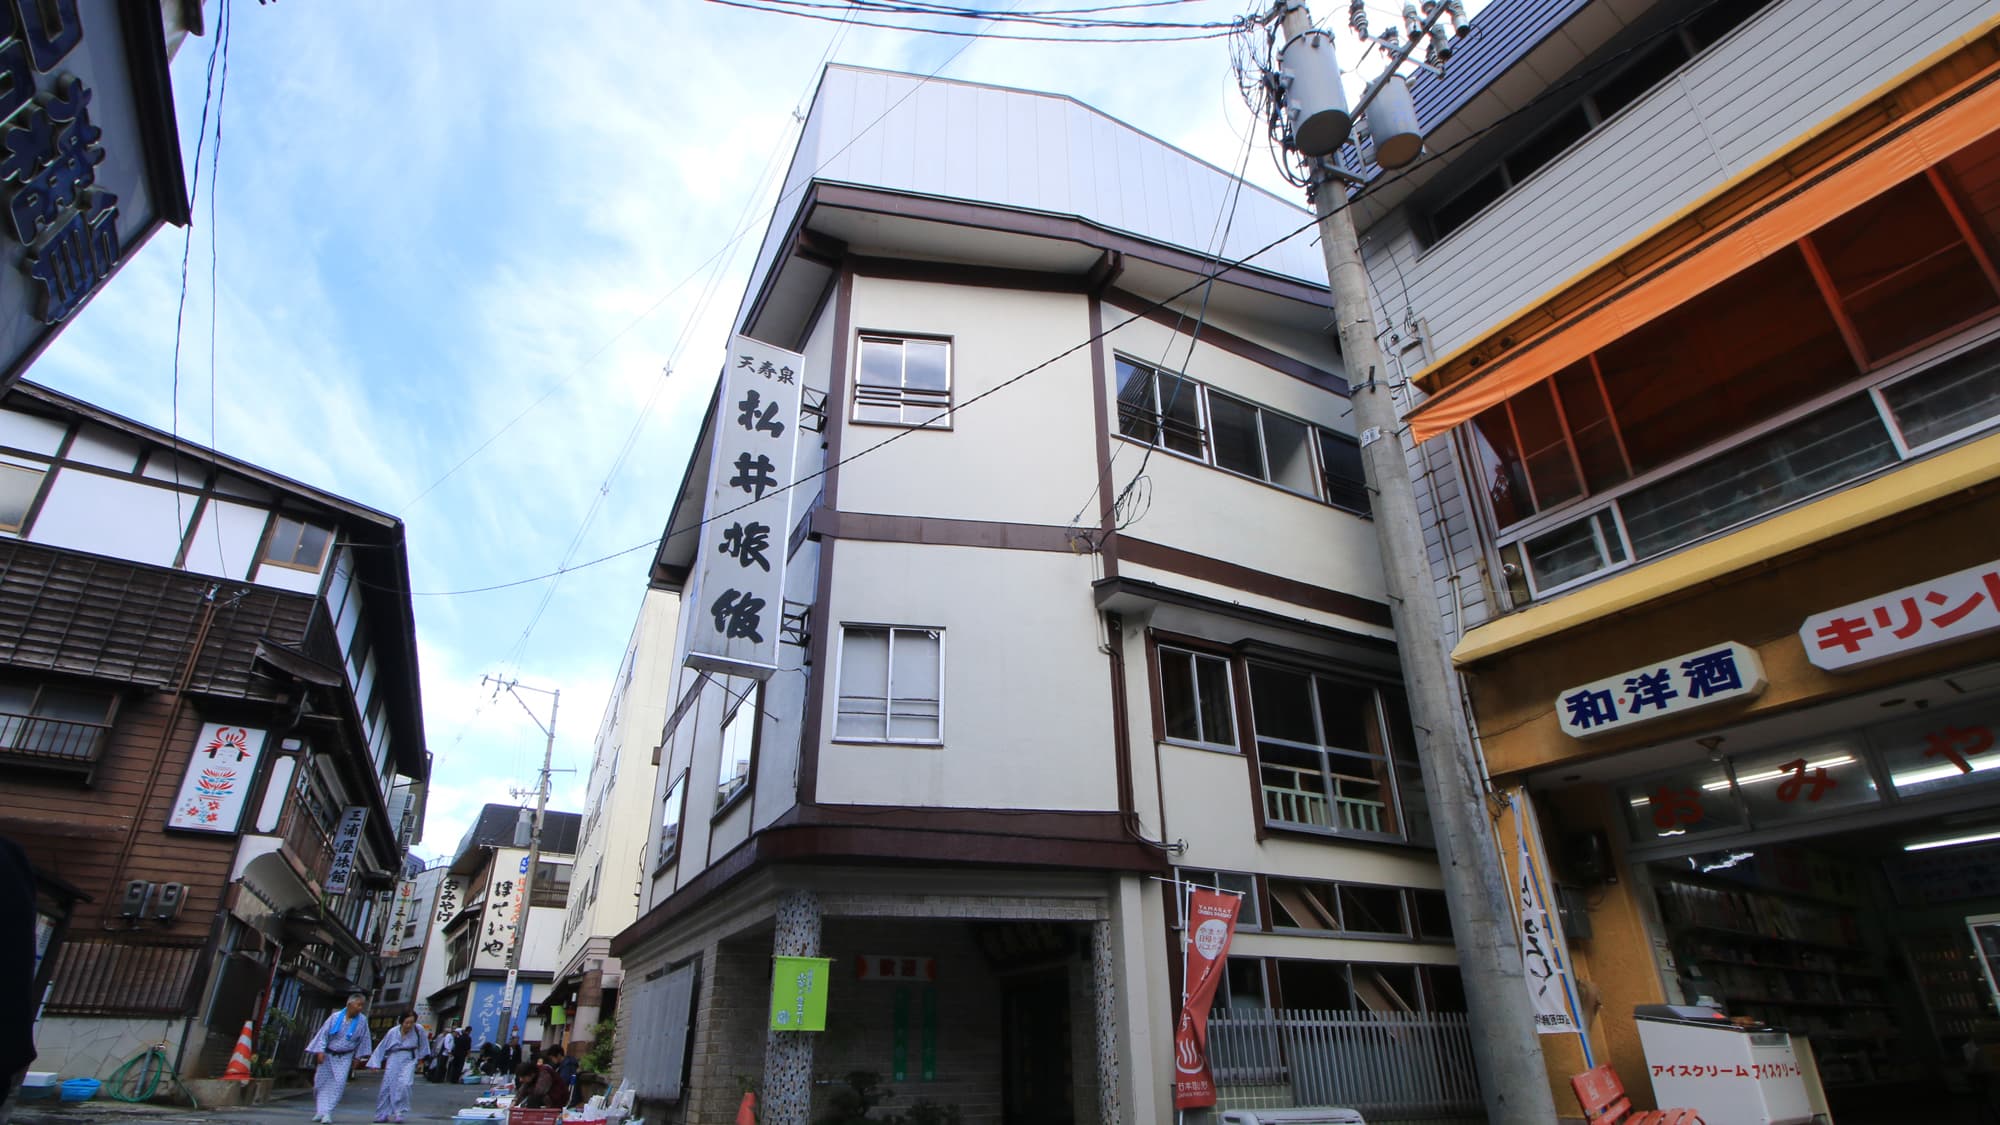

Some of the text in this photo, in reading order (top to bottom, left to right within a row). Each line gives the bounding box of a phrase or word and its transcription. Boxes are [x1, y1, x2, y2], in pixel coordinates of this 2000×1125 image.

[737, 354, 795, 385] 天寿泉
[710, 389, 785, 644] 松井旅館
[330, 810, 362, 883] 三浦屋旅館
[436, 880, 460, 923] おみやげ
[1651, 1064, 1749, 1077] アイスクリーム
